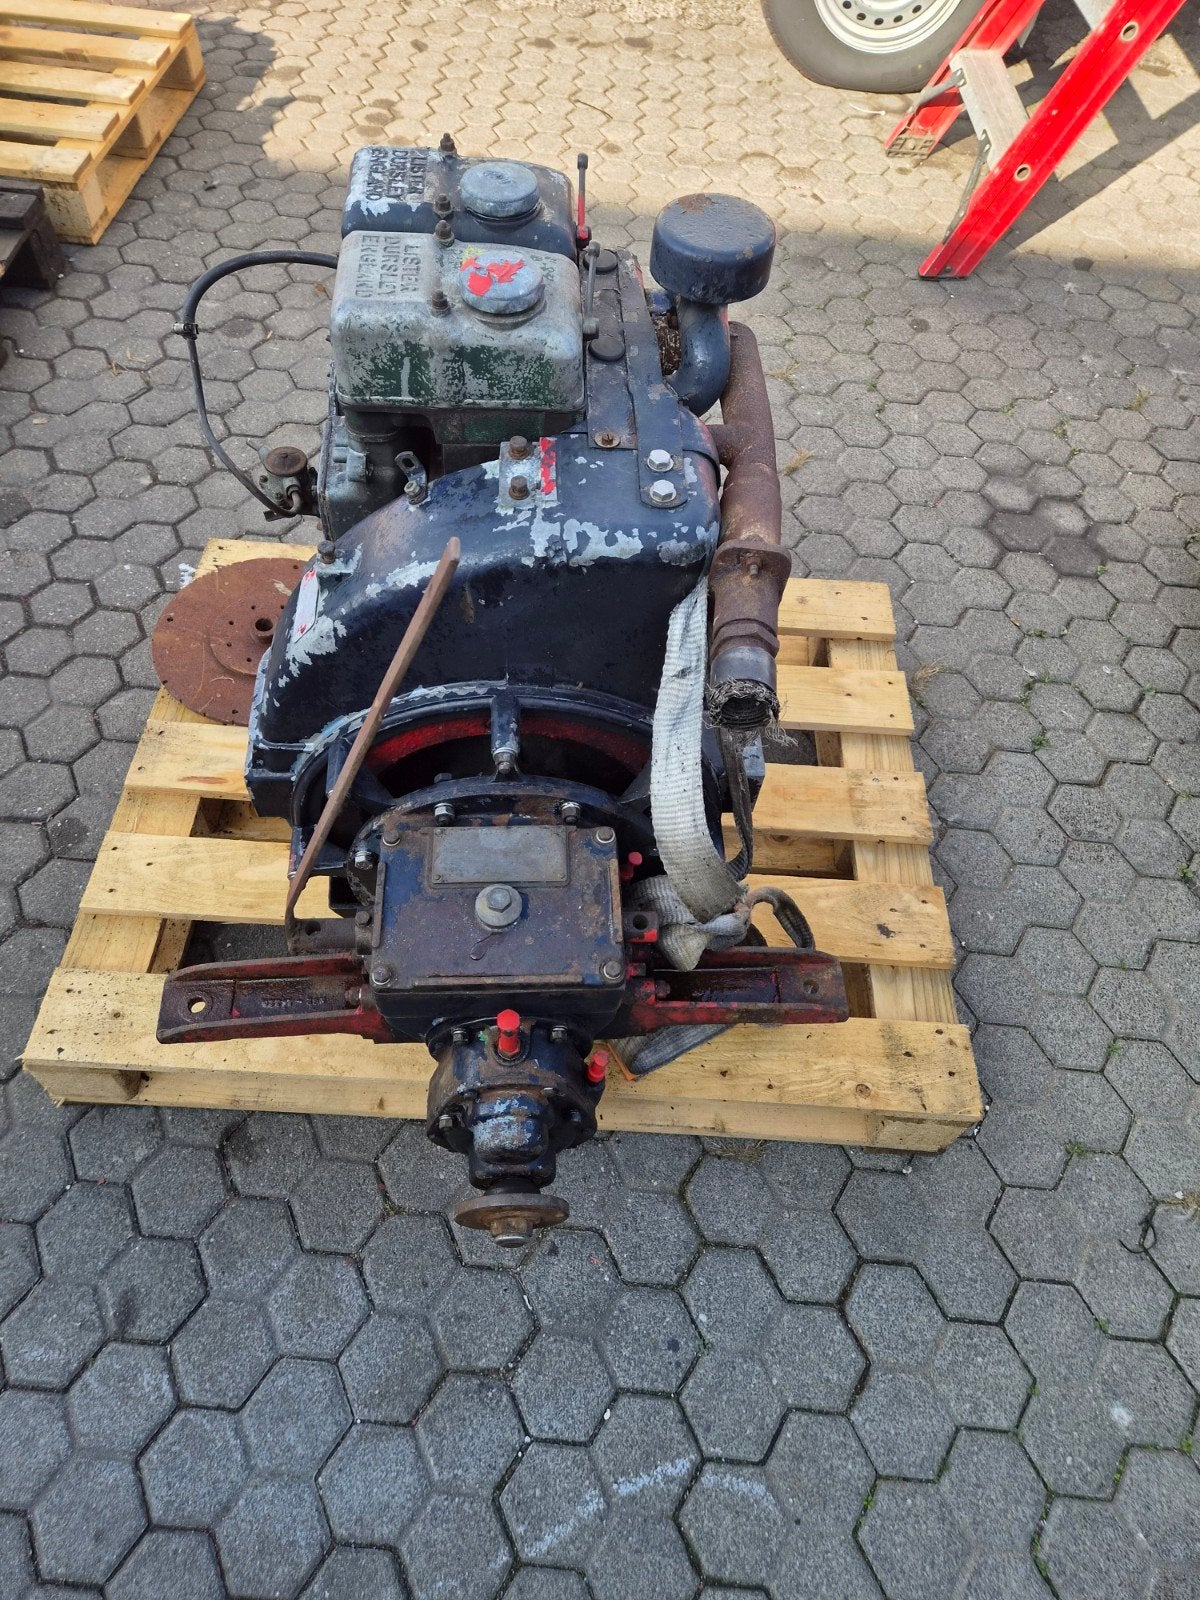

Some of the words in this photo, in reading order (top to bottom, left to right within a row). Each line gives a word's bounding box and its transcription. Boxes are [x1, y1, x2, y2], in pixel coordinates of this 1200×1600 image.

[407, 157, 428, 195] LISTER
[355, 235, 380, 298] ENGLAND
[378, 236, 401, 296] DURSLEY
[400, 245, 421, 292] LISTER
